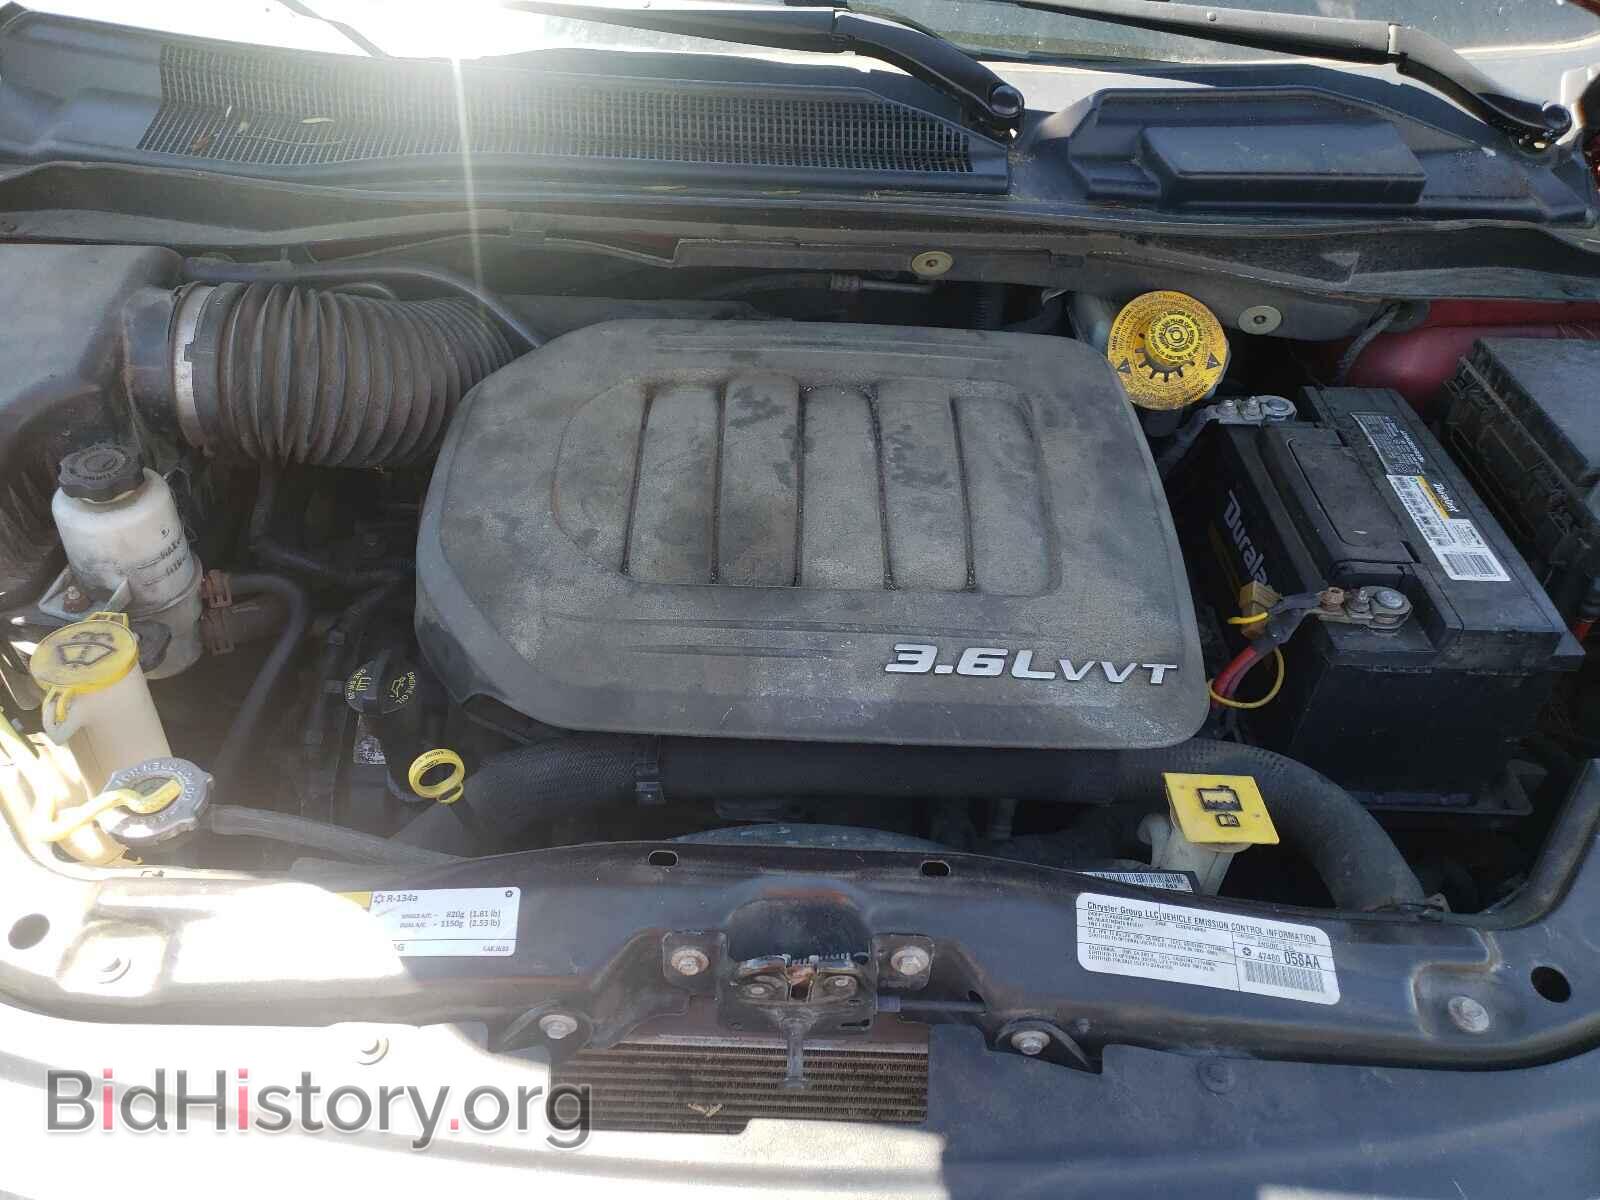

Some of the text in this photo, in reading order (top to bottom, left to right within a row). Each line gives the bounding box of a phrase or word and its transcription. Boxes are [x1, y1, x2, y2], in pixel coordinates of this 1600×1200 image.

[1224, 489, 1268, 586] Durala
[884, 643, 1178, 684] 3.6L VVT
[386, 894, 418, 903] R-134a
[1087, 902, 1159, 919] Chrysler Group LLC
[469, 920, 488, 928] (2.53
[490, 919, 500, 928] lb)
[1162, 912, 1192, 923] VEHICLE
[1194, 917, 1229, 929] EMISSION
[1230, 922, 1264, 936] CONTROL
[1266, 928, 1317, 943] INFORMATION
